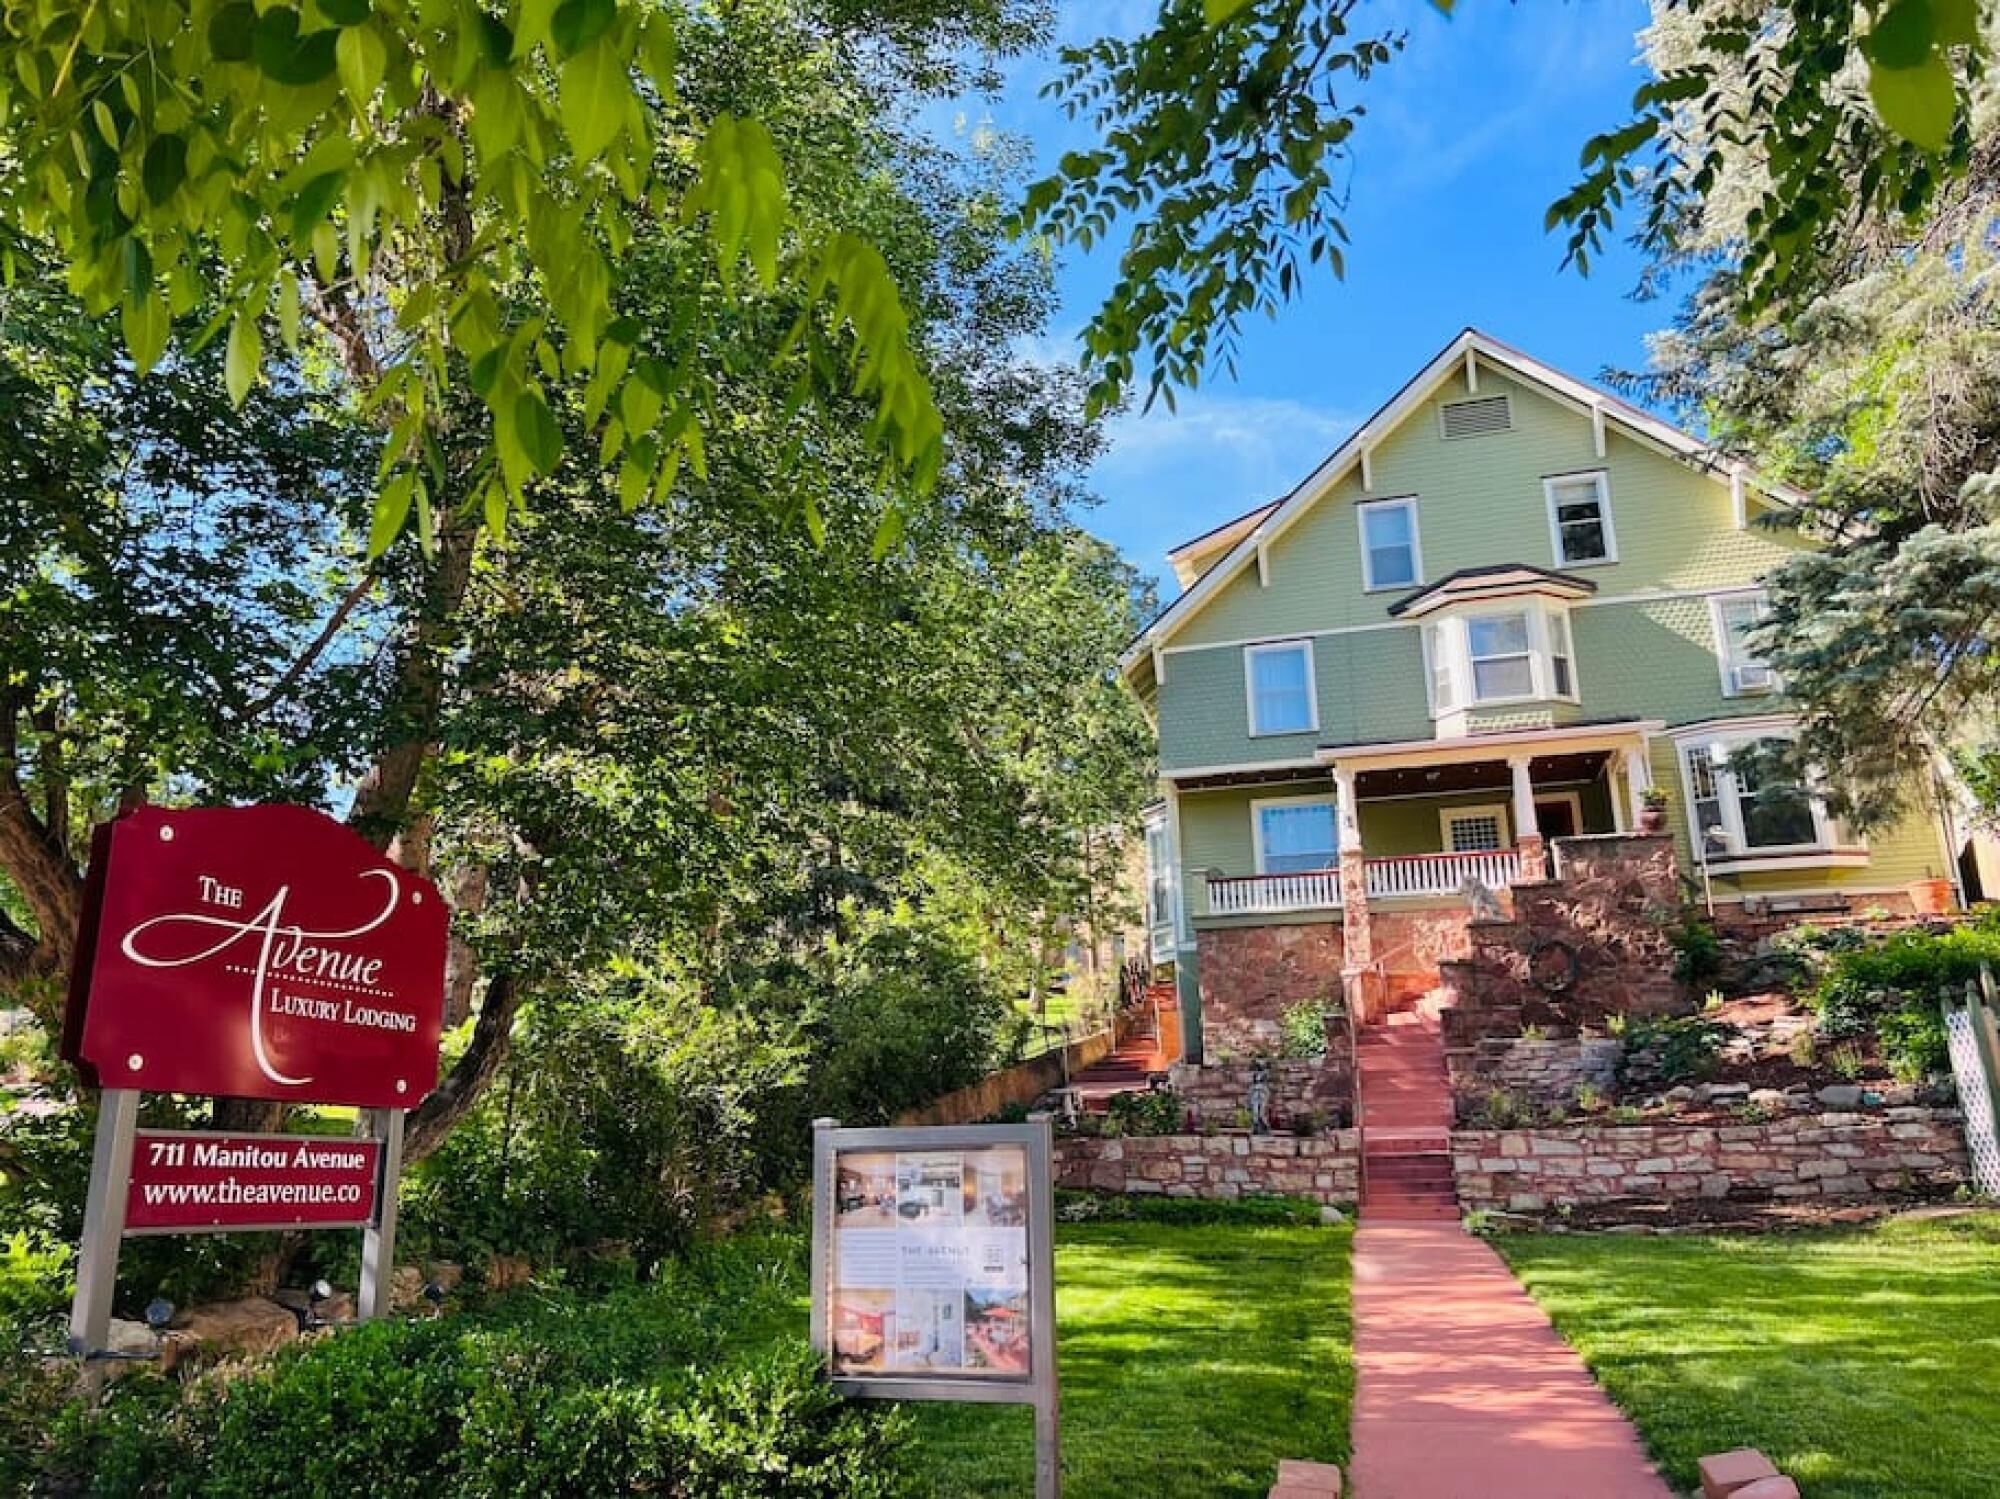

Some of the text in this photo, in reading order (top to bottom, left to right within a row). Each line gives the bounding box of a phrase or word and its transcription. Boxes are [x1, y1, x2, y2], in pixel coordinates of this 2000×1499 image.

[199, 875, 243, 908] THE
[270, 987, 416, 1033] LUXURY LODGING
[150, 1143, 365, 1169] 711 Manitou Avenue
[143, 1176, 361, 1205] www.theavenue.co
